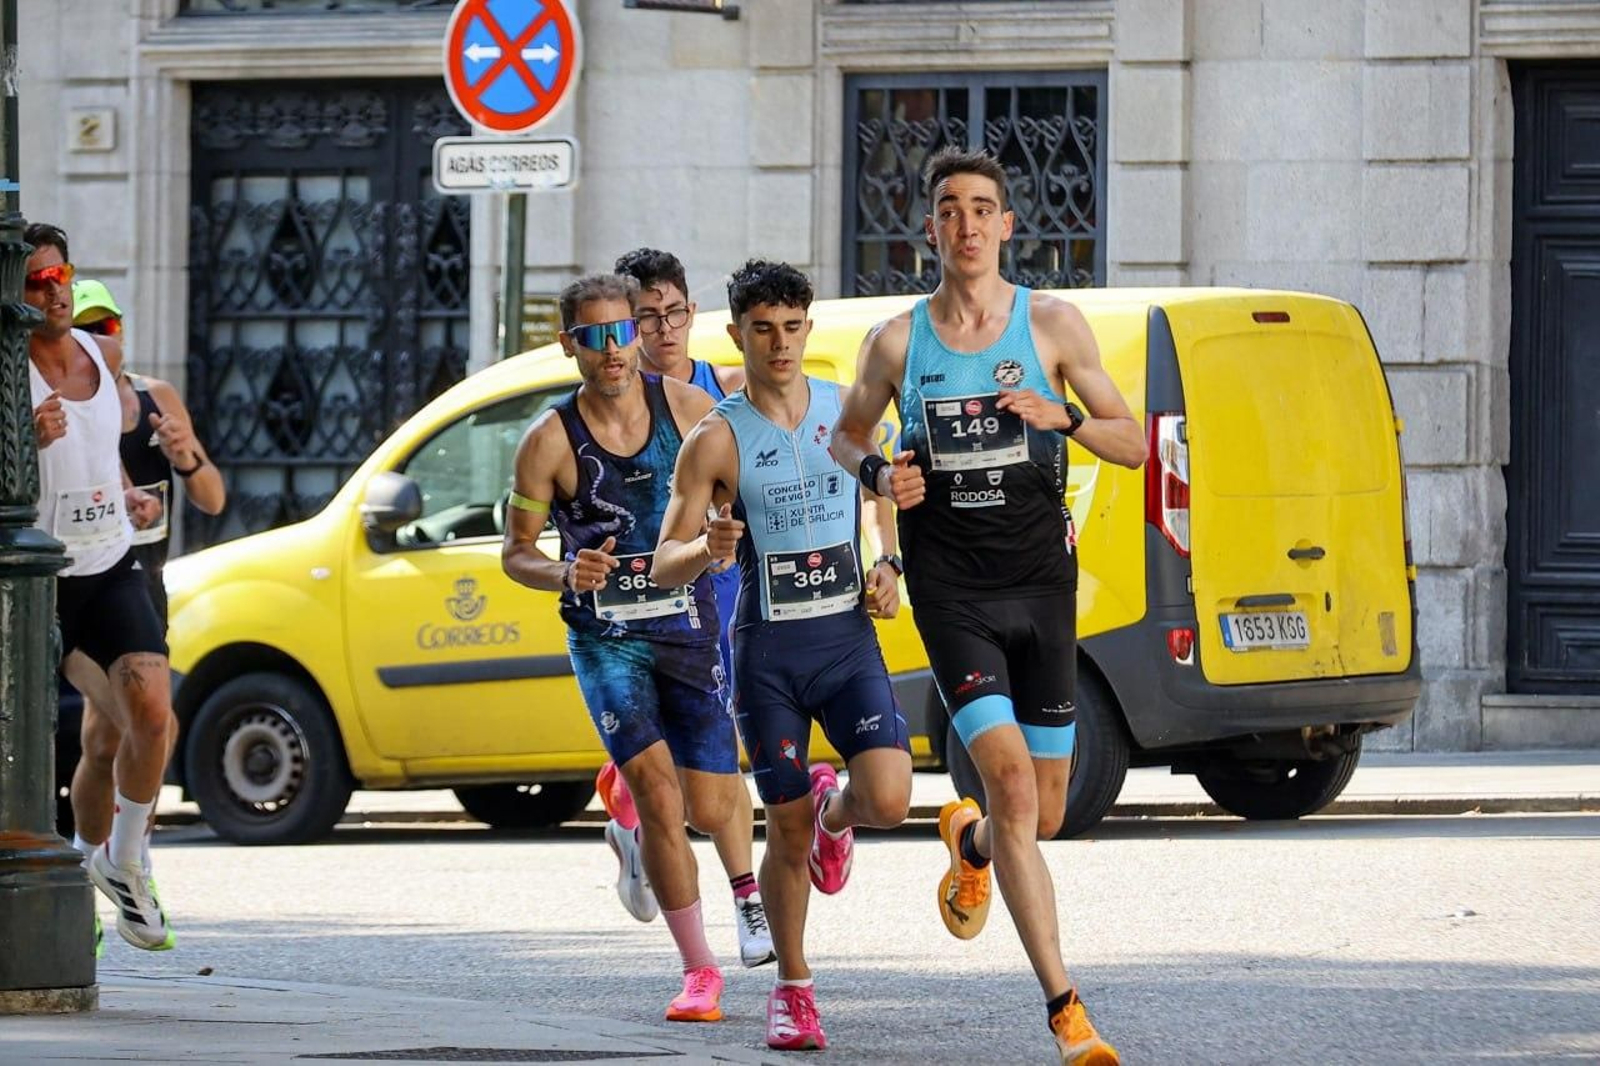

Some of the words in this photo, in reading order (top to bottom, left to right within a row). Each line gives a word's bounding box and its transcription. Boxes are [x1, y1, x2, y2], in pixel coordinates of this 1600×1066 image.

[950, 416, 1000, 438] 149
[754, 459, 779, 468] ZICO
[768, 480, 816, 496] CONCELLO
[950, 489, 1006, 502] RODOSA
[774, 496, 788, 504] DE
[788, 490, 811, 502] VIGO
[71, 502, 116, 523] 1574
[790, 518, 806, 527] DE
[808, 510, 845, 524] GALICIA
[794, 565, 838, 588] 364
[1234, 616, 1275, 642] 1653
[1277, 615, 1306, 640] KSG
